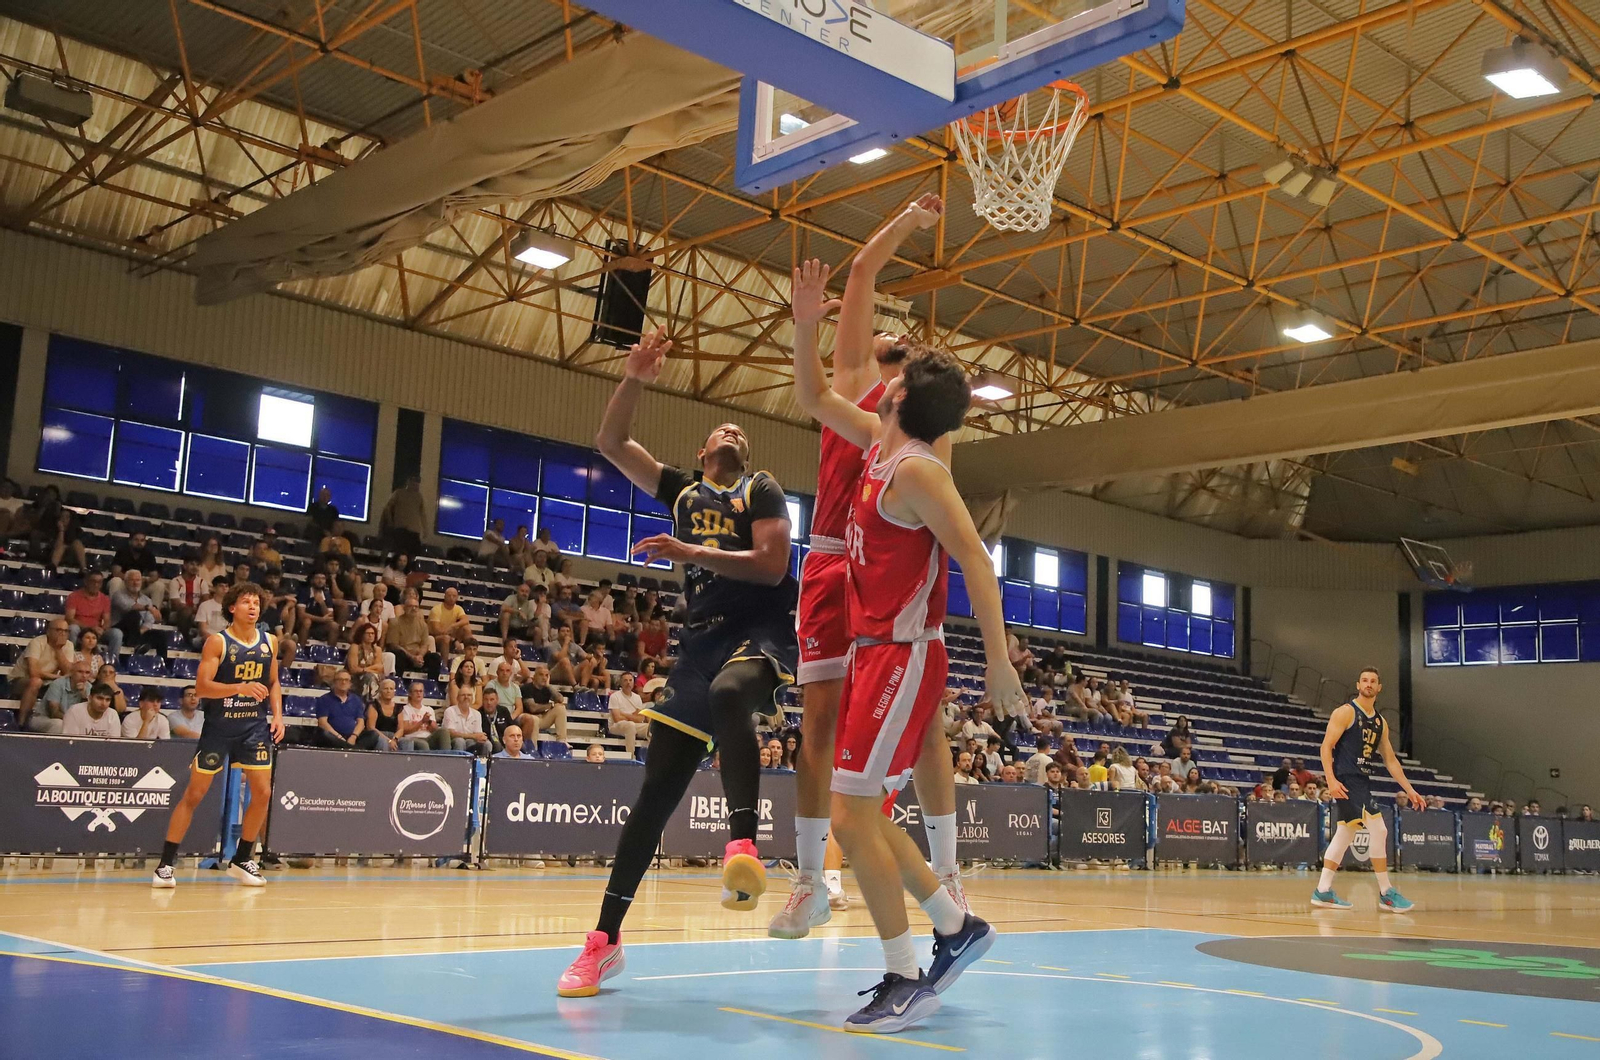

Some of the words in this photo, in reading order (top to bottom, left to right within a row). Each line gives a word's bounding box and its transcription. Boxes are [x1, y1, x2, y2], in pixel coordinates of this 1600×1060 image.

[234, 661, 264, 680] CBA
[888, 665, 905, 687] PINAR
[884, 685, 896, 695] EL
[872, 692, 892, 720] COLEGIO
[256, 750, 268, 761] 10
[78, 765, 118, 777] HERMANOS
[118, 766, 139, 777] CABO
[92, 777, 109, 785] DESDE
[36, 789, 50, 803] LA
[51, 790, 106, 806] BOUTIQUE
[107, 791, 122, 804] DE
[123, 792, 135, 805] LA
[136, 792, 170, 806] CARNE
[300, 797, 335, 806] Escuderos
[336, 798, 366, 807] Asesores
[506, 792, 631, 825] damex.io
[690, 796, 774, 820] IBERR
[689, 819, 726, 833] Energía
[1008, 813, 1040, 829] ROA
[956, 826, 989, 839] LABOR
[1255, 821, 1310, 838] CENTRAL
[1081, 832, 1126, 844] ASESORES
